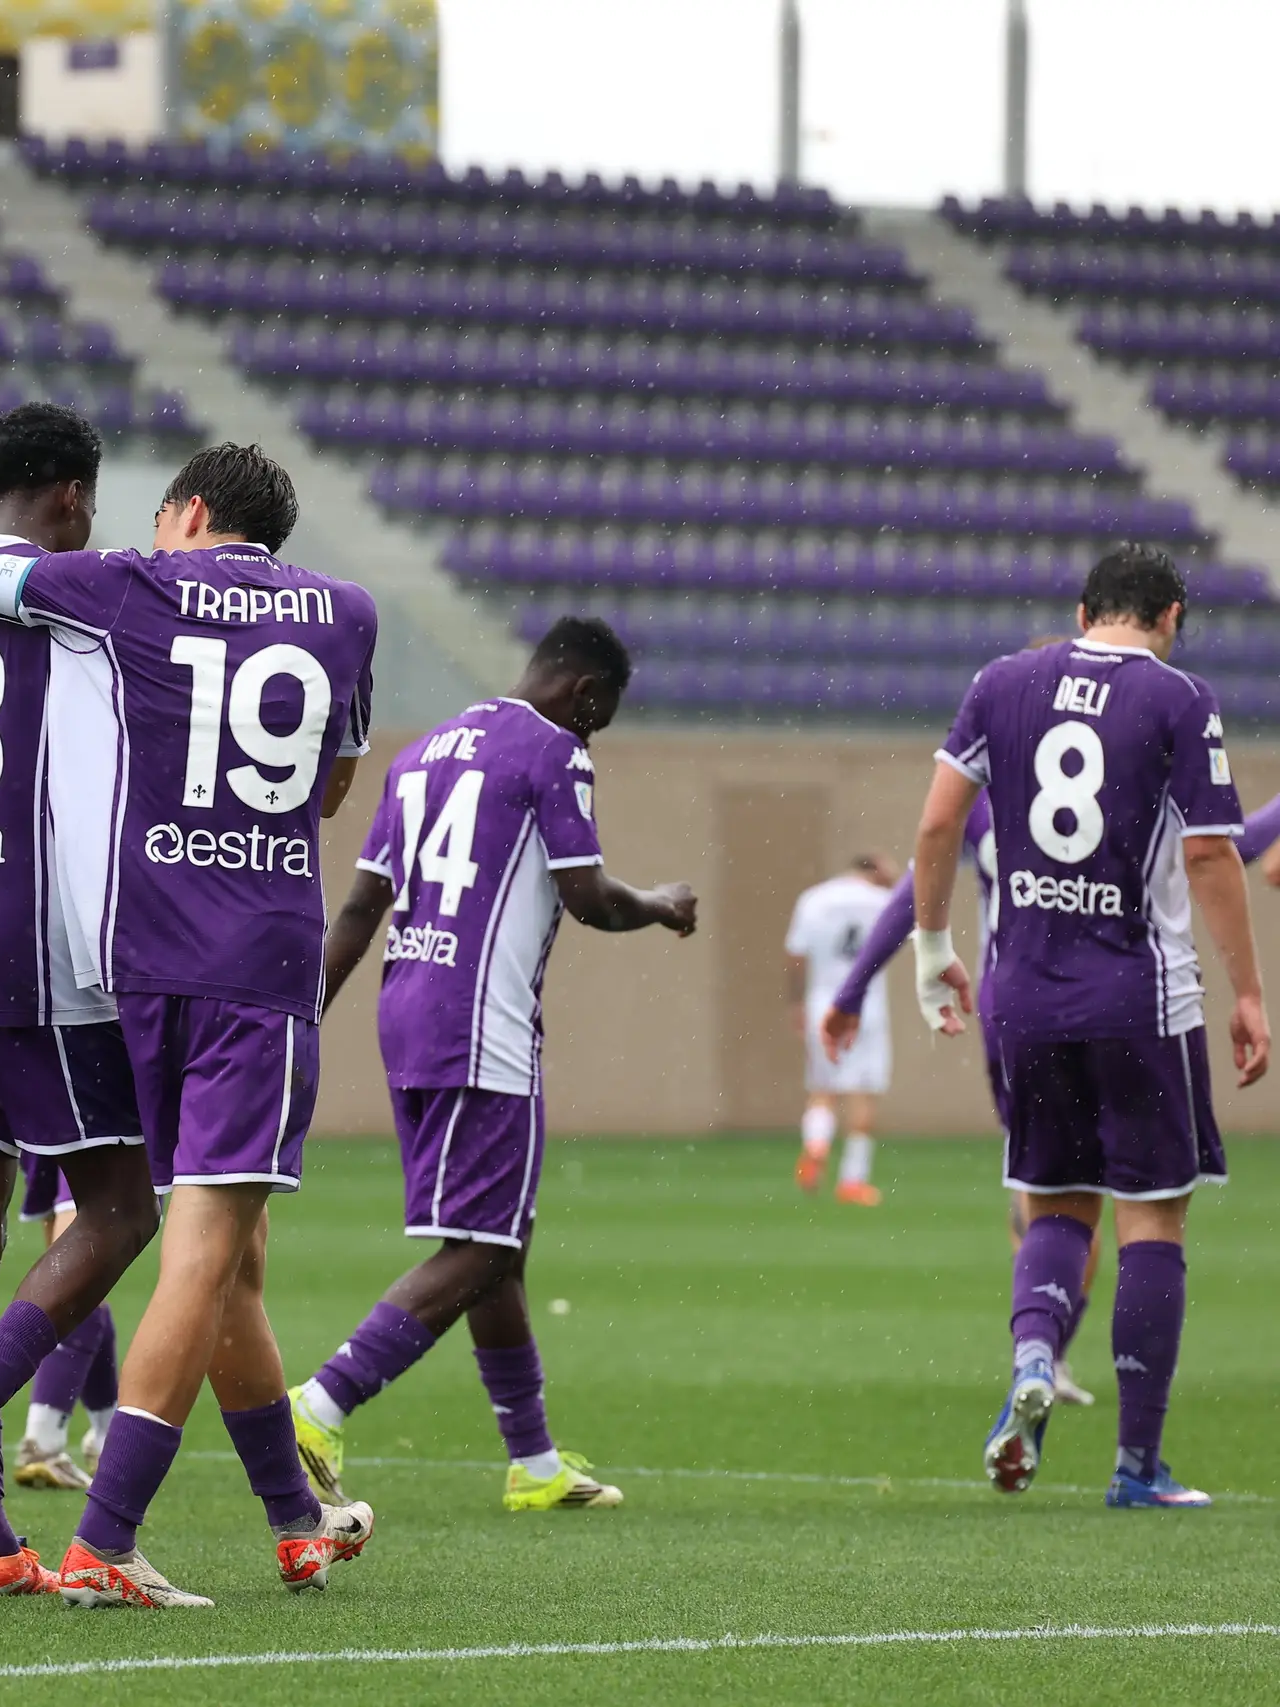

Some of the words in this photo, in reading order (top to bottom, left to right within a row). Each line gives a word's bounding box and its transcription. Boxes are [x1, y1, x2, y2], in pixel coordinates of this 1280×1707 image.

[176, 579, 334, 625] TRAPANI
[169, 635, 332, 814] 19
[1052, 675, 1111, 717] DELI
[392, 769, 485, 917] 14
[1029, 720, 1105, 863] 8
